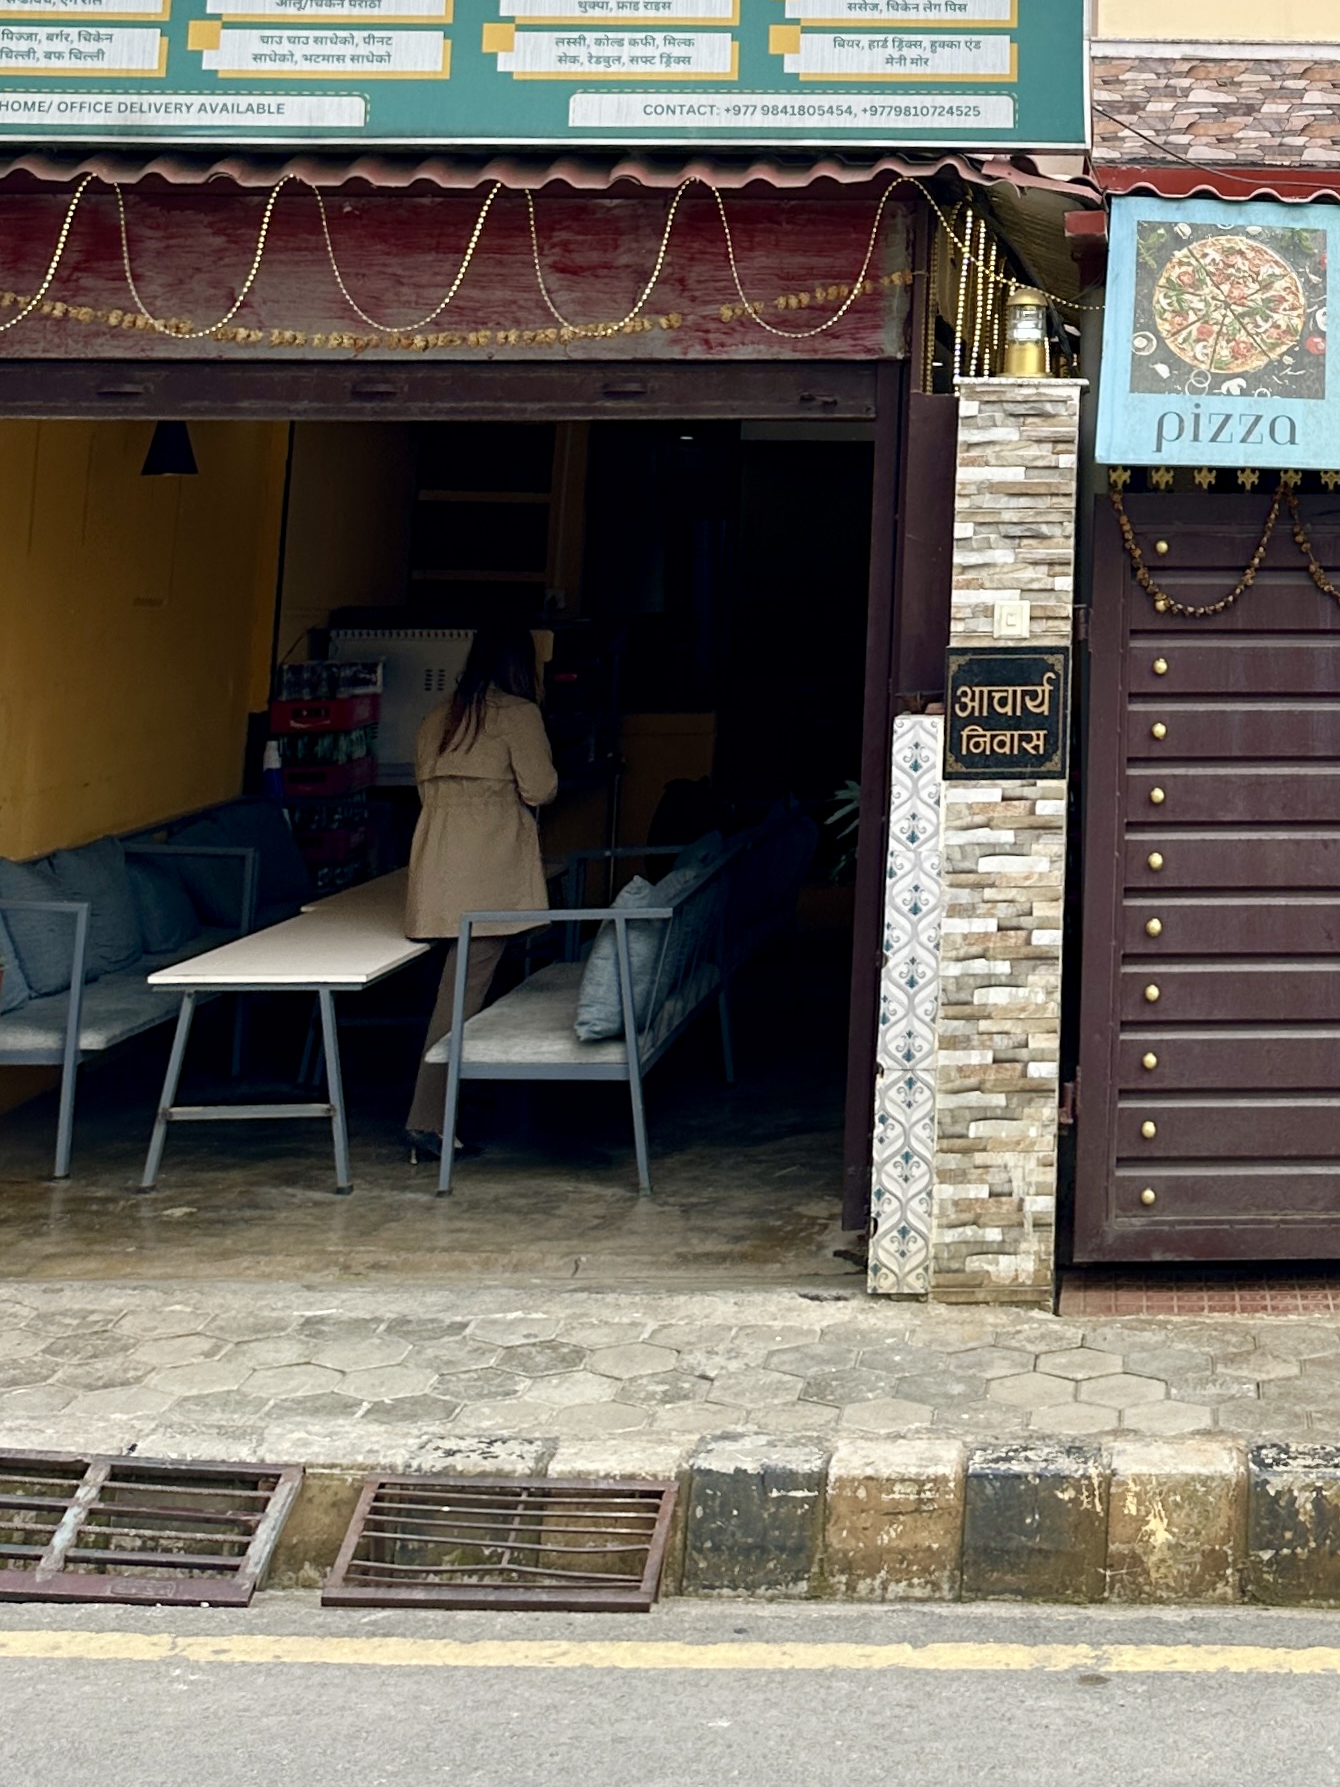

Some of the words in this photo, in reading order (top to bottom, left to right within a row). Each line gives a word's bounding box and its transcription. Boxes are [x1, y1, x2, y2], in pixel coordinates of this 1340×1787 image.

[57, 101, 113, 114] OFFICE
[117, 101, 194, 114] DELIVERY
[197, 102, 286, 115] AVAILABLE
[643, 104, 721, 117] CONTACT:
[724, 105, 757, 117] +977
[861, 105, 981, 118] +9779810724525
[1154, 403, 1299, 453] pizza
[955, 672, 1056, 717] आचार्य
[960, 725, 1048, 755] निवास
